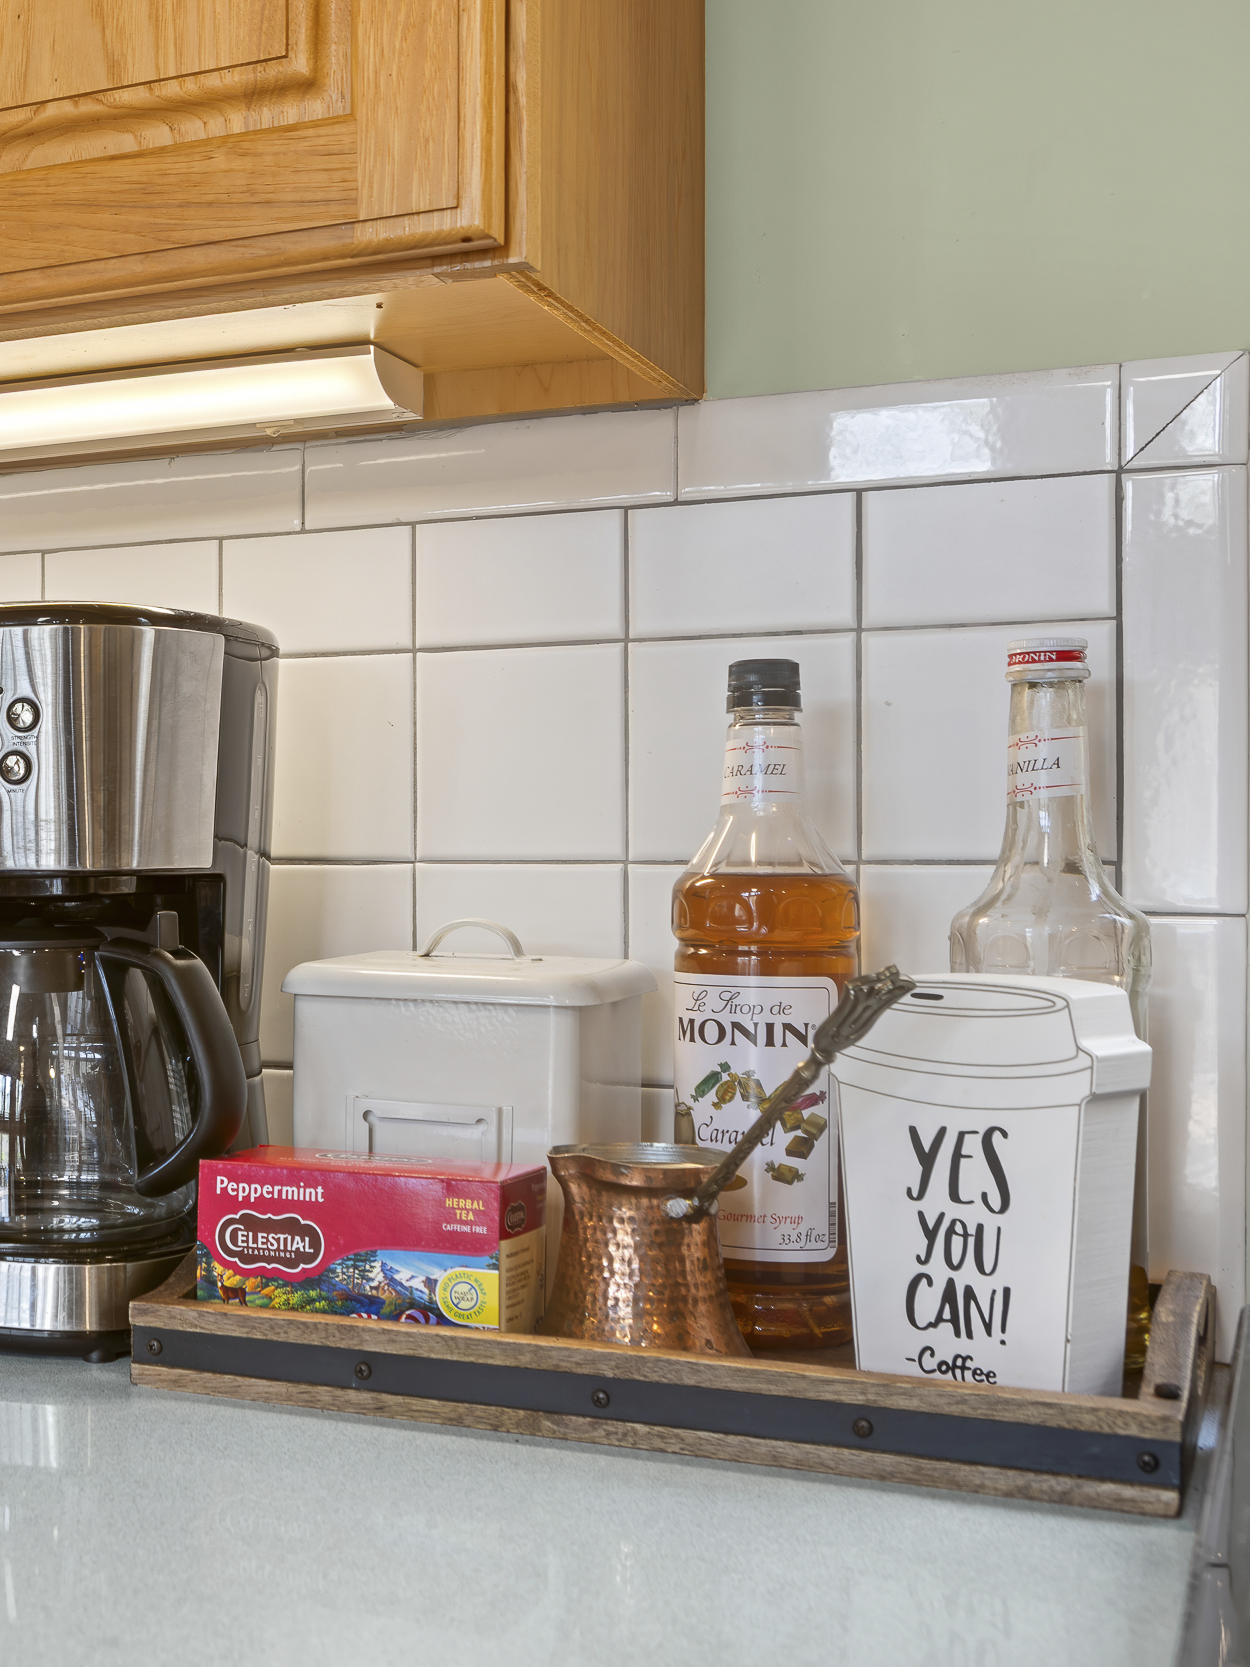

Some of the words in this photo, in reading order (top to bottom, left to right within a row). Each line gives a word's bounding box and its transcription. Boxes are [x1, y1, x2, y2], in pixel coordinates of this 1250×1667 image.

[724, 763, 787, 778] CARAMEL
[686, 990, 708, 1012] Le
[711, 990, 764, 1021] Sirop
[770, 1002, 792, 1016] de
[906, 1125, 1011, 1215] YES
[216, 1175, 325, 1203] Peppermint
[445, 1197, 485, 1211] HERBAL
[455, 1209, 475, 1221] TEA
[717, 1208, 767, 1225] Gourmet
[770, 1212, 804, 1230] Syrup
[442, 1223, 471, 1233] CAFFEINE
[472, 1225, 488, 1235] FREE
[225, 1224, 314, 1253] CELESTIAL
[779, 1231, 803, 1246] 33.8
[814, 1233, 827, 1243] oz
[915, 1209, 1002, 1277] YOU
[243, 1247, 296, 1259] SEASONINGS
[447, 1272, 473, 1284] PLASTIC
[453, 1311, 474, 1320] GREAT
[905, 1272, 1011, 1346] CAN!
